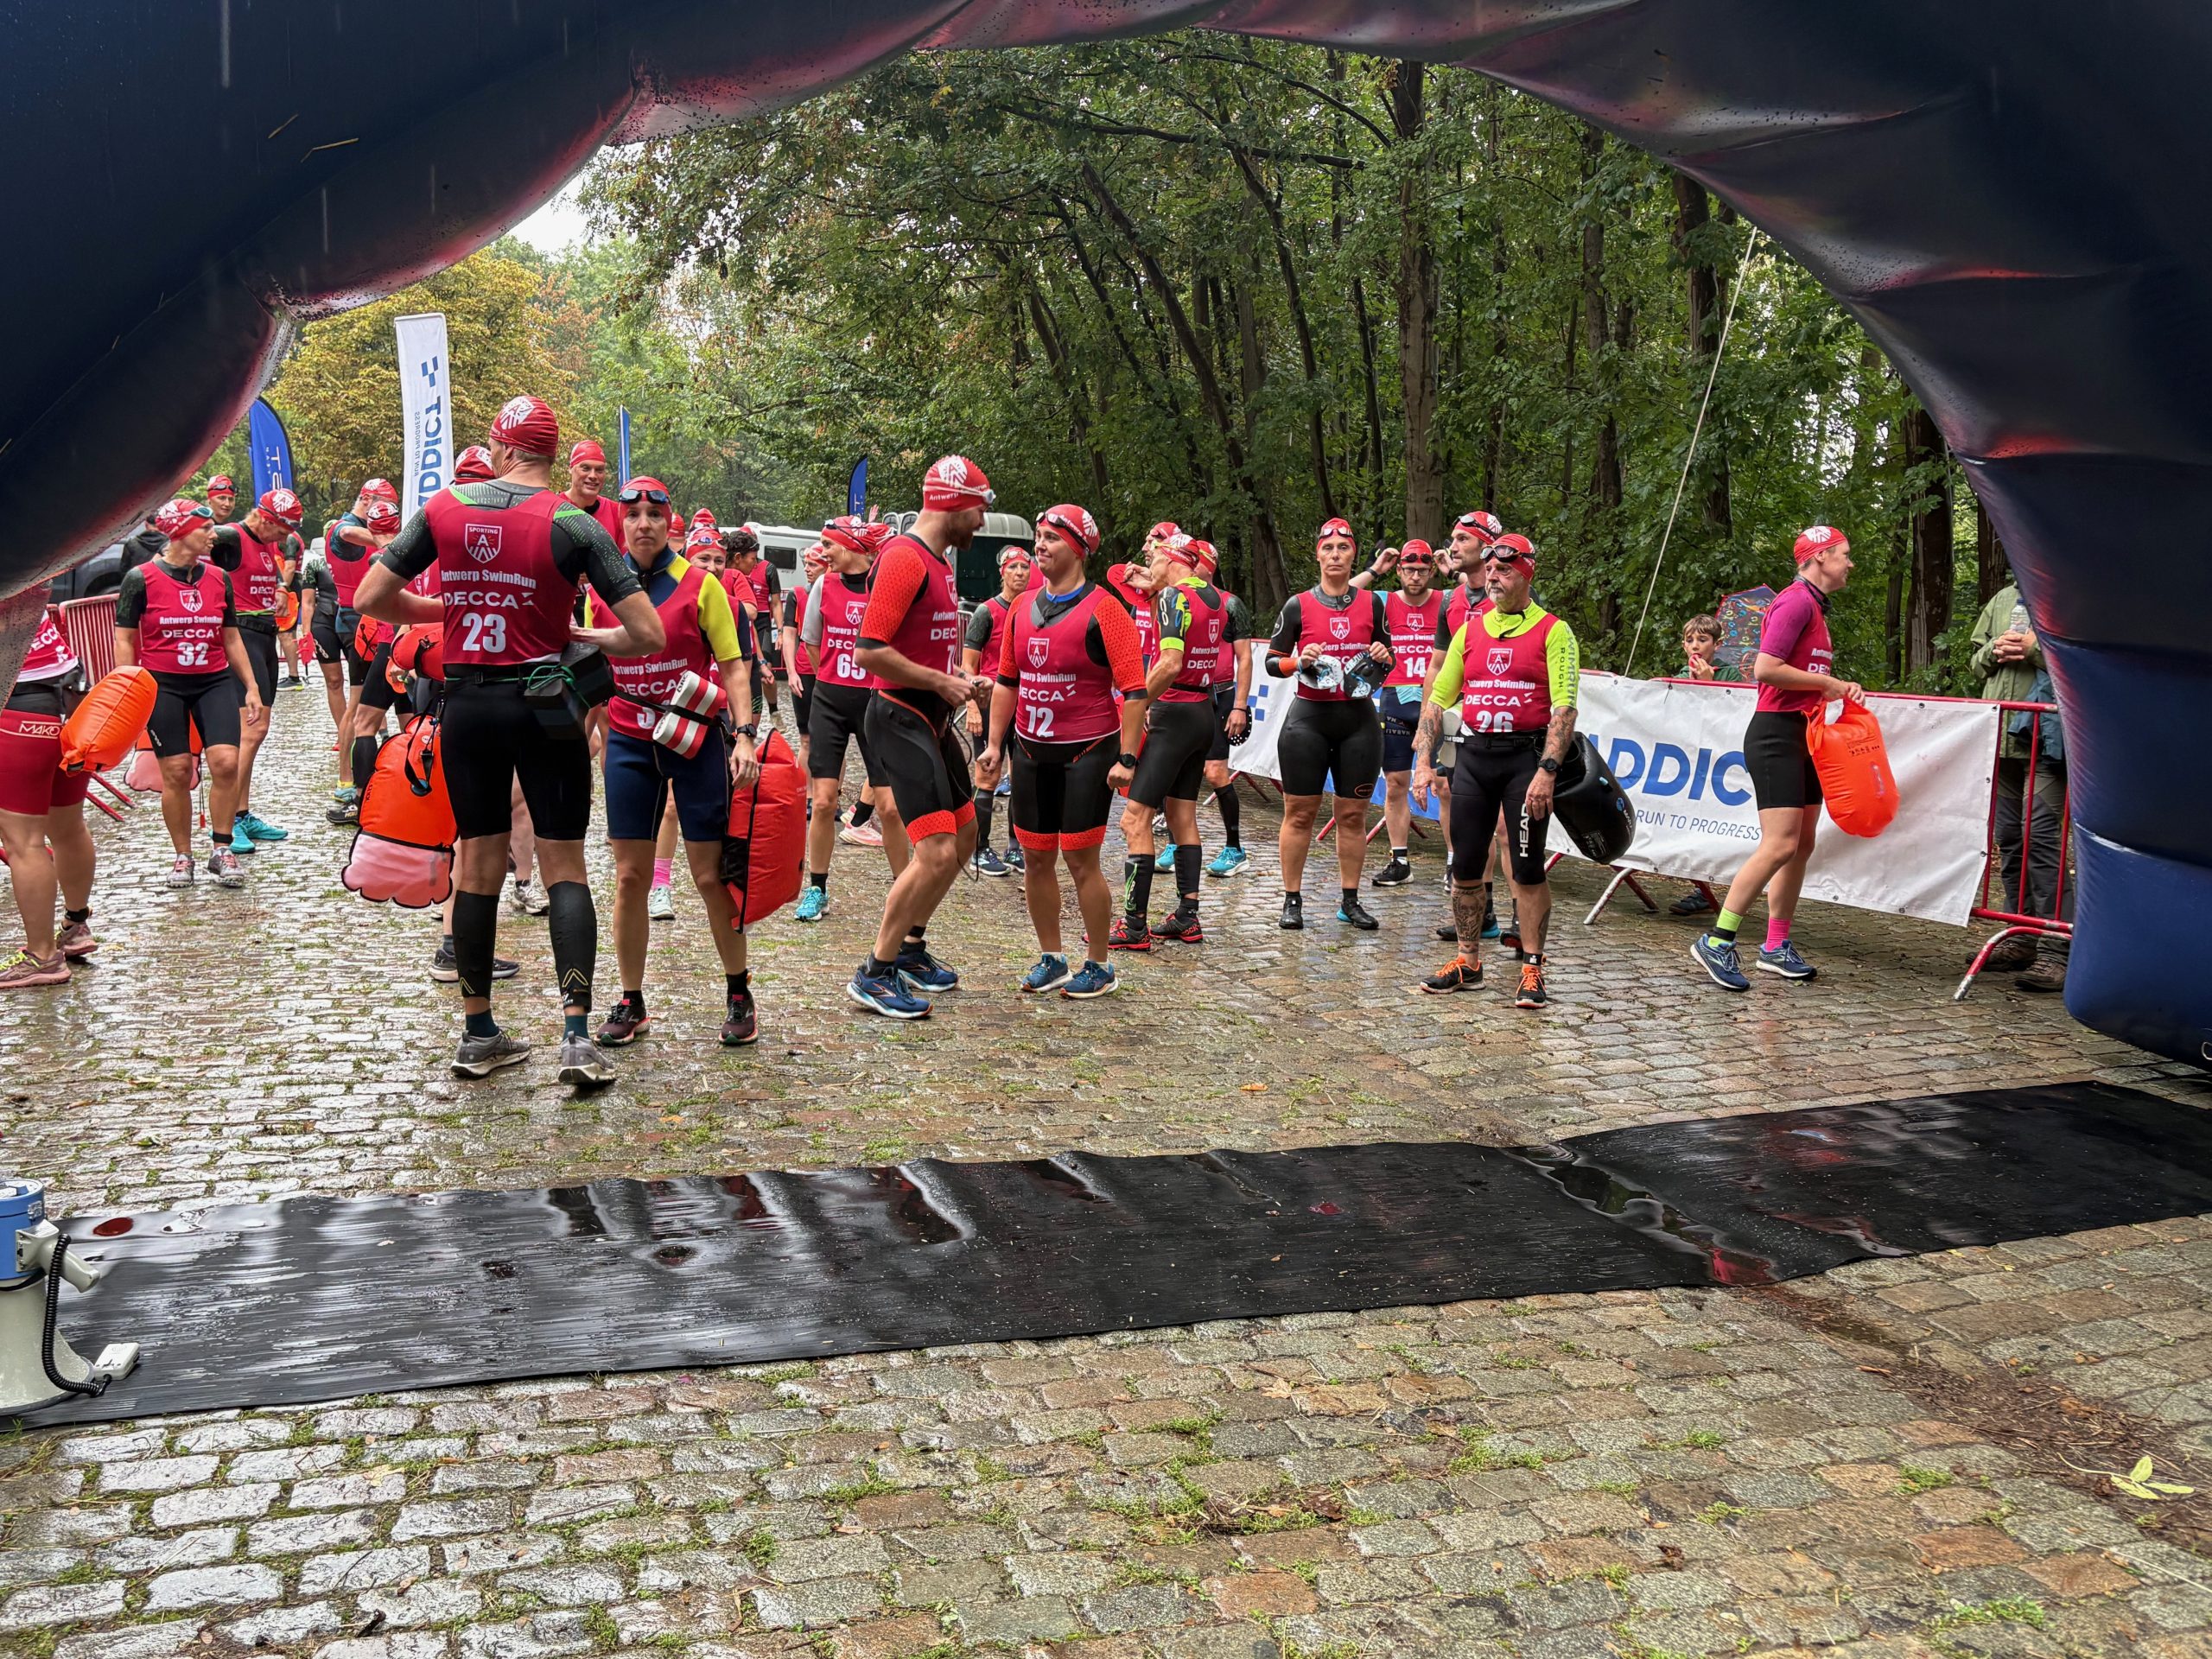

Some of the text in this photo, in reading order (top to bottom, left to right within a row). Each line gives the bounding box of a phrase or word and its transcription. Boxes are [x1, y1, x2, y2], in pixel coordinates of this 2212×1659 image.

[481, 569, 537, 589] SwimRun
[443, 591, 519, 610] DECCA
[159, 616, 193, 625] Antwerp
[28, 623, 59, 654] ECC
[162, 628, 214, 639] DECCA
[462, 612, 506, 653] 23
[177, 641, 209, 666] 32
[645, 658, 689, 674] SwimRun
[1403, 657, 1427, 678] 14
[1036, 672, 1077, 683] SwimRun
[1494, 679, 1535, 690] SwimRun
[1020, 685, 1065, 702] ECCA
[1465, 694, 1522, 707] DECCA
[1476, 710, 1514, 733] 26
[1588, 733, 1752, 807] DDIC
[1635, 810, 1666, 826] RUN
[1669, 814, 1687, 830] TO
[1689, 817, 1763, 842] PROGRESS
